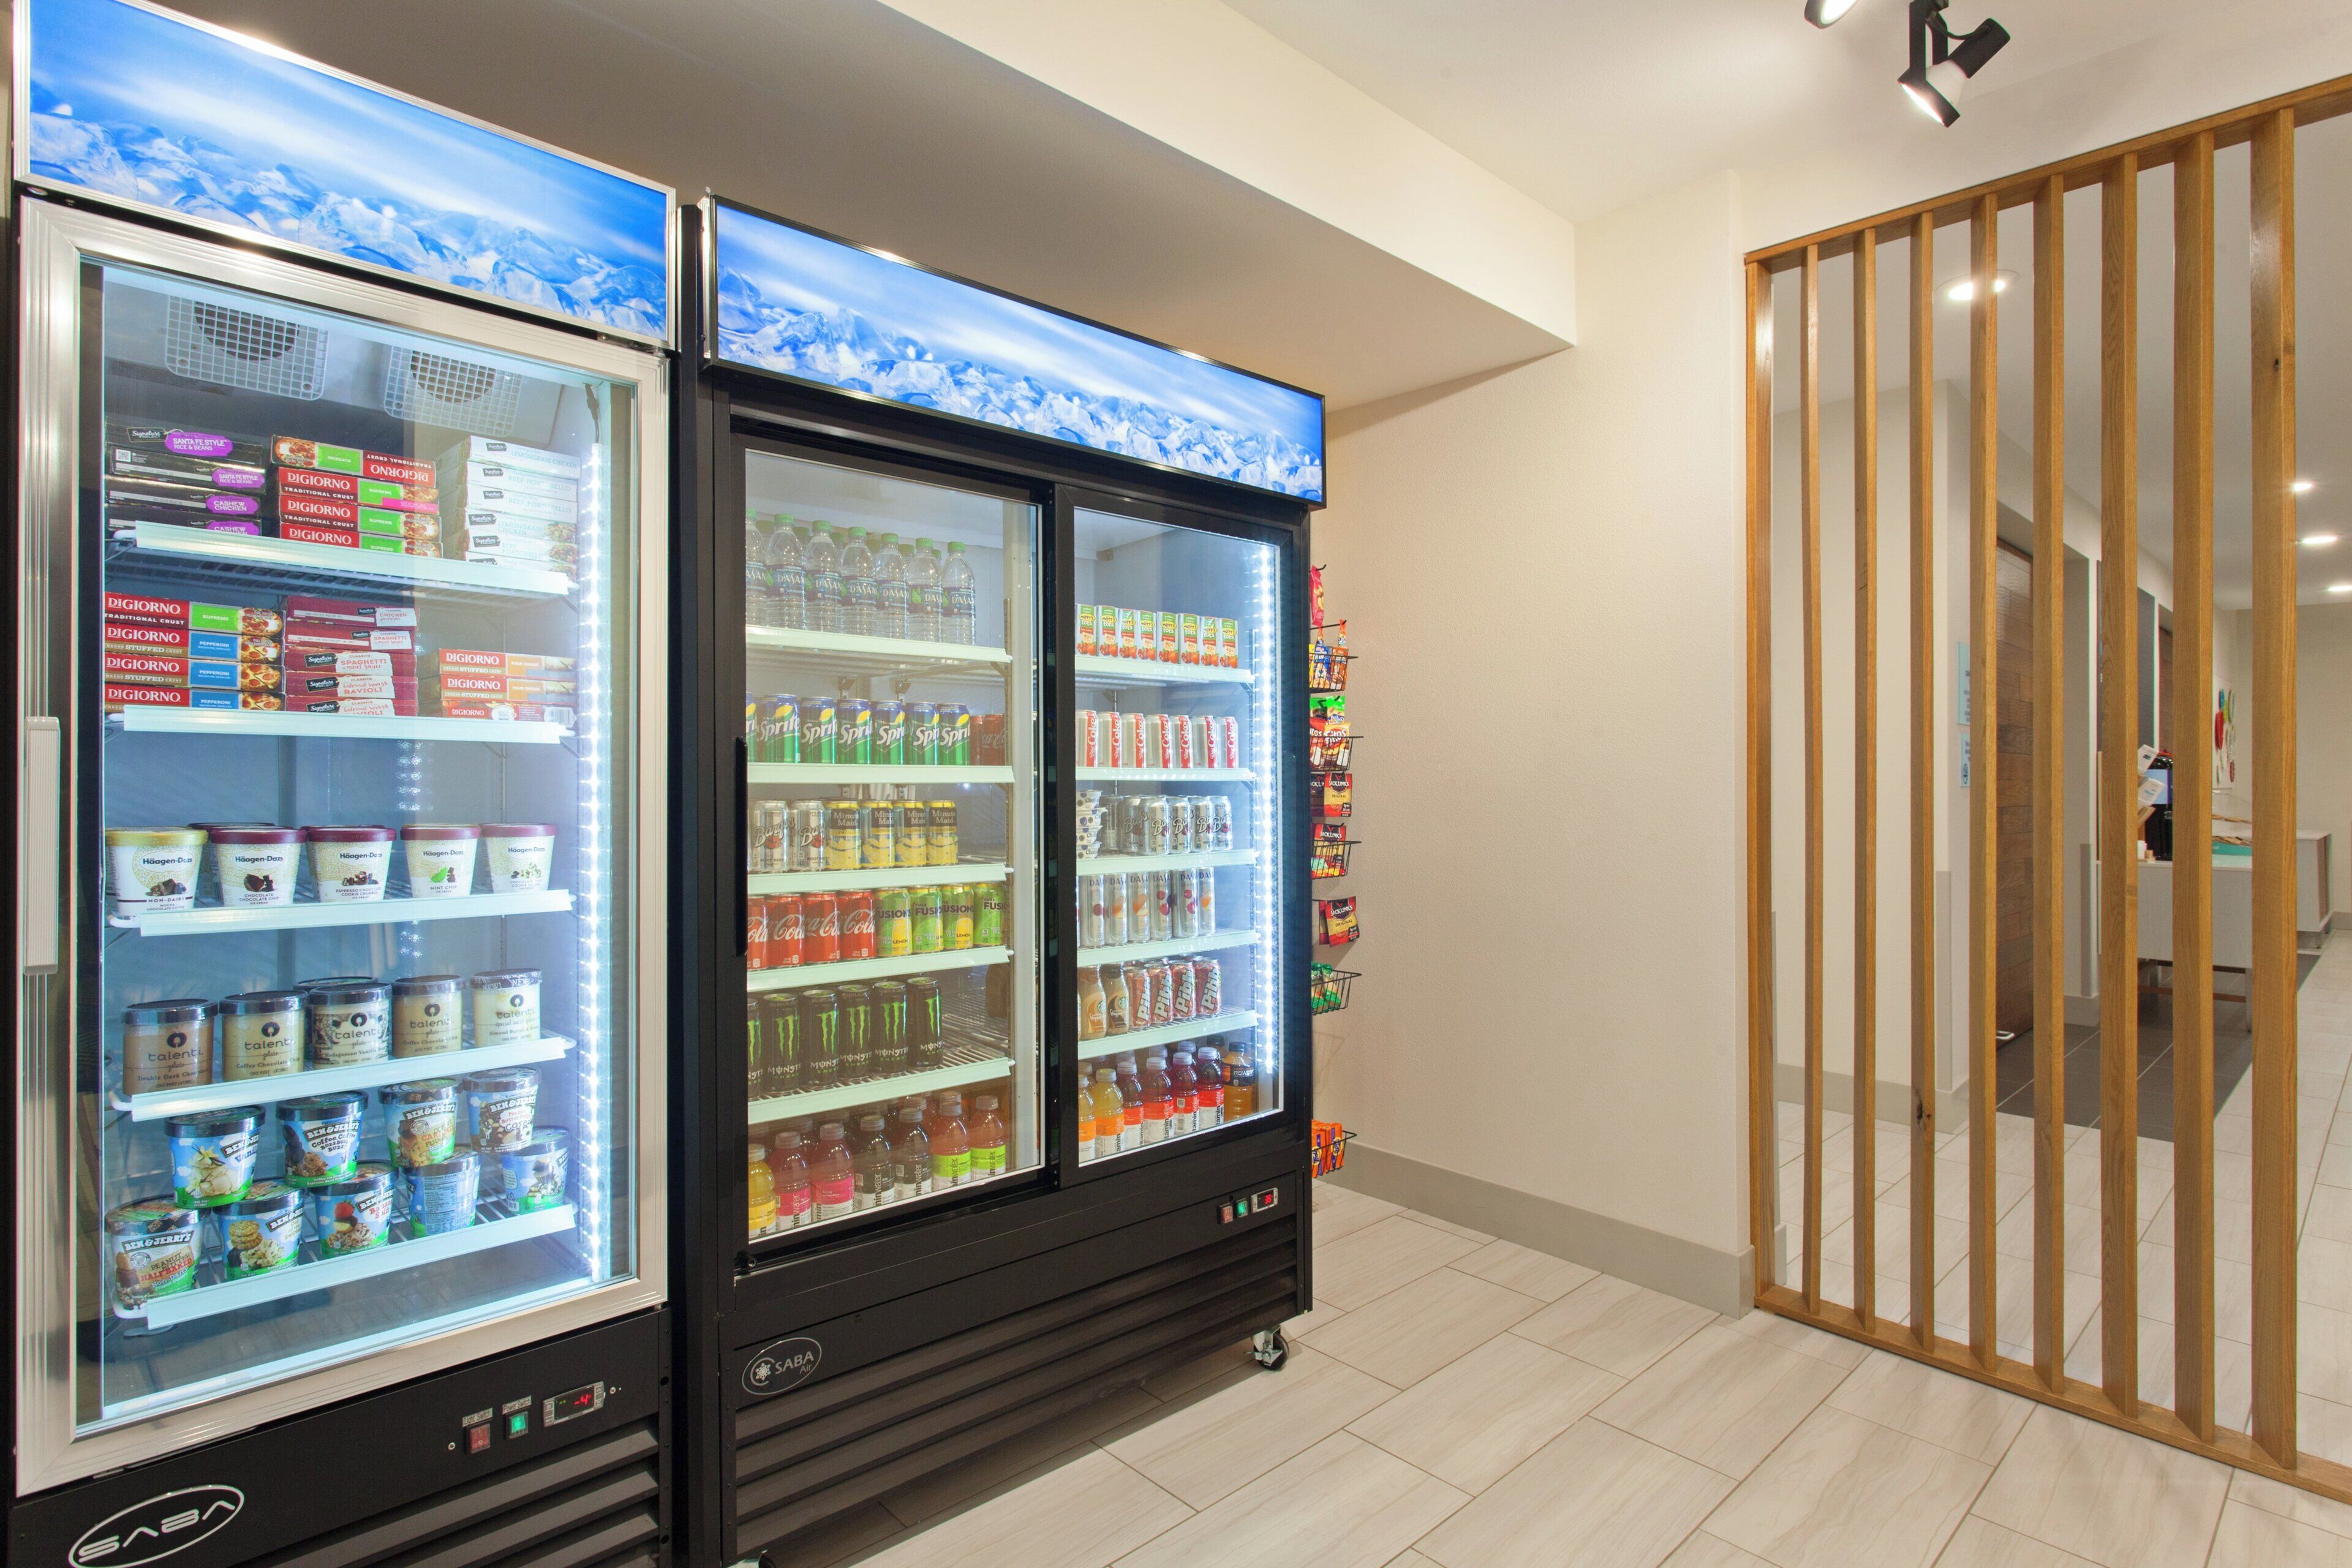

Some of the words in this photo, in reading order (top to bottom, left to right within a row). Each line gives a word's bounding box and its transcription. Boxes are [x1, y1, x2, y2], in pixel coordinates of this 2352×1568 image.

[390, 458, 432, 469] TRADITIONAL
[511, 451, 551, 463] LEMONGRASS
[552, 459, 577, 468] CHICKEN
[371, 464, 429, 482] DIGIORNO
[287, 473, 350, 490] DIGIORNO
[285, 487, 331, 497] TRADITIONAL
[287, 500, 350, 518] DIGIORNO
[284, 515, 331, 525] TRADITIONAL
[497, 522, 543, 532] LEMONGRASS
[289, 528, 352, 545] DIGIORNO
[108, 597, 181, 614] DIGIORNO
[105, 613, 157, 623] TRADITIONAL
[107, 627, 180, 643] DIGIORNO
[125, 644, 165, 653] STUFFED
[107, 657, 179, 673] DIGIORNO
[446, 653, 499, 665] DIGIORNO
[124, 674, 164, 682] STUFFED
[448, 679, 500, 689] DIGIORNO
[108, 688, 181, 702] DIGIORNO
[758, 712, 800, 742] Sprite
[1341, 905, 1353, 914] LINK'S
[1175, 970, 1193, 1013] Pibb
[1201, 967, 1218, 1010] Pibb
[496, 1009, 534, 1019] talenti
[335, 1029, 380, 1039] talenti
[245, 1038, 294, 1050] talenti
[148, 1048, 204, 1062] talenti
[262, 1051, 278, 1060] gelato
[167, 1063, 185, 1072] gelato
[1265, 1194, 1272, 1205] 35
[151, 1253, 182, 1271] PEANUT
[141, 1271, 163, 1281] HALF
[166, 1258, 192, 1275] BAKED
[775, 1351, 814, 1374] SABA
[799, 1364, 812, 1374] Air
[503, 1403, 516, 1413] Power
[517, 1398, 530, 1408] Switch
[463, 1415, 476, 1425] Light
[477, 1411, 491, 1420] Switch
[78, 1501, 236, 1562] SABA
